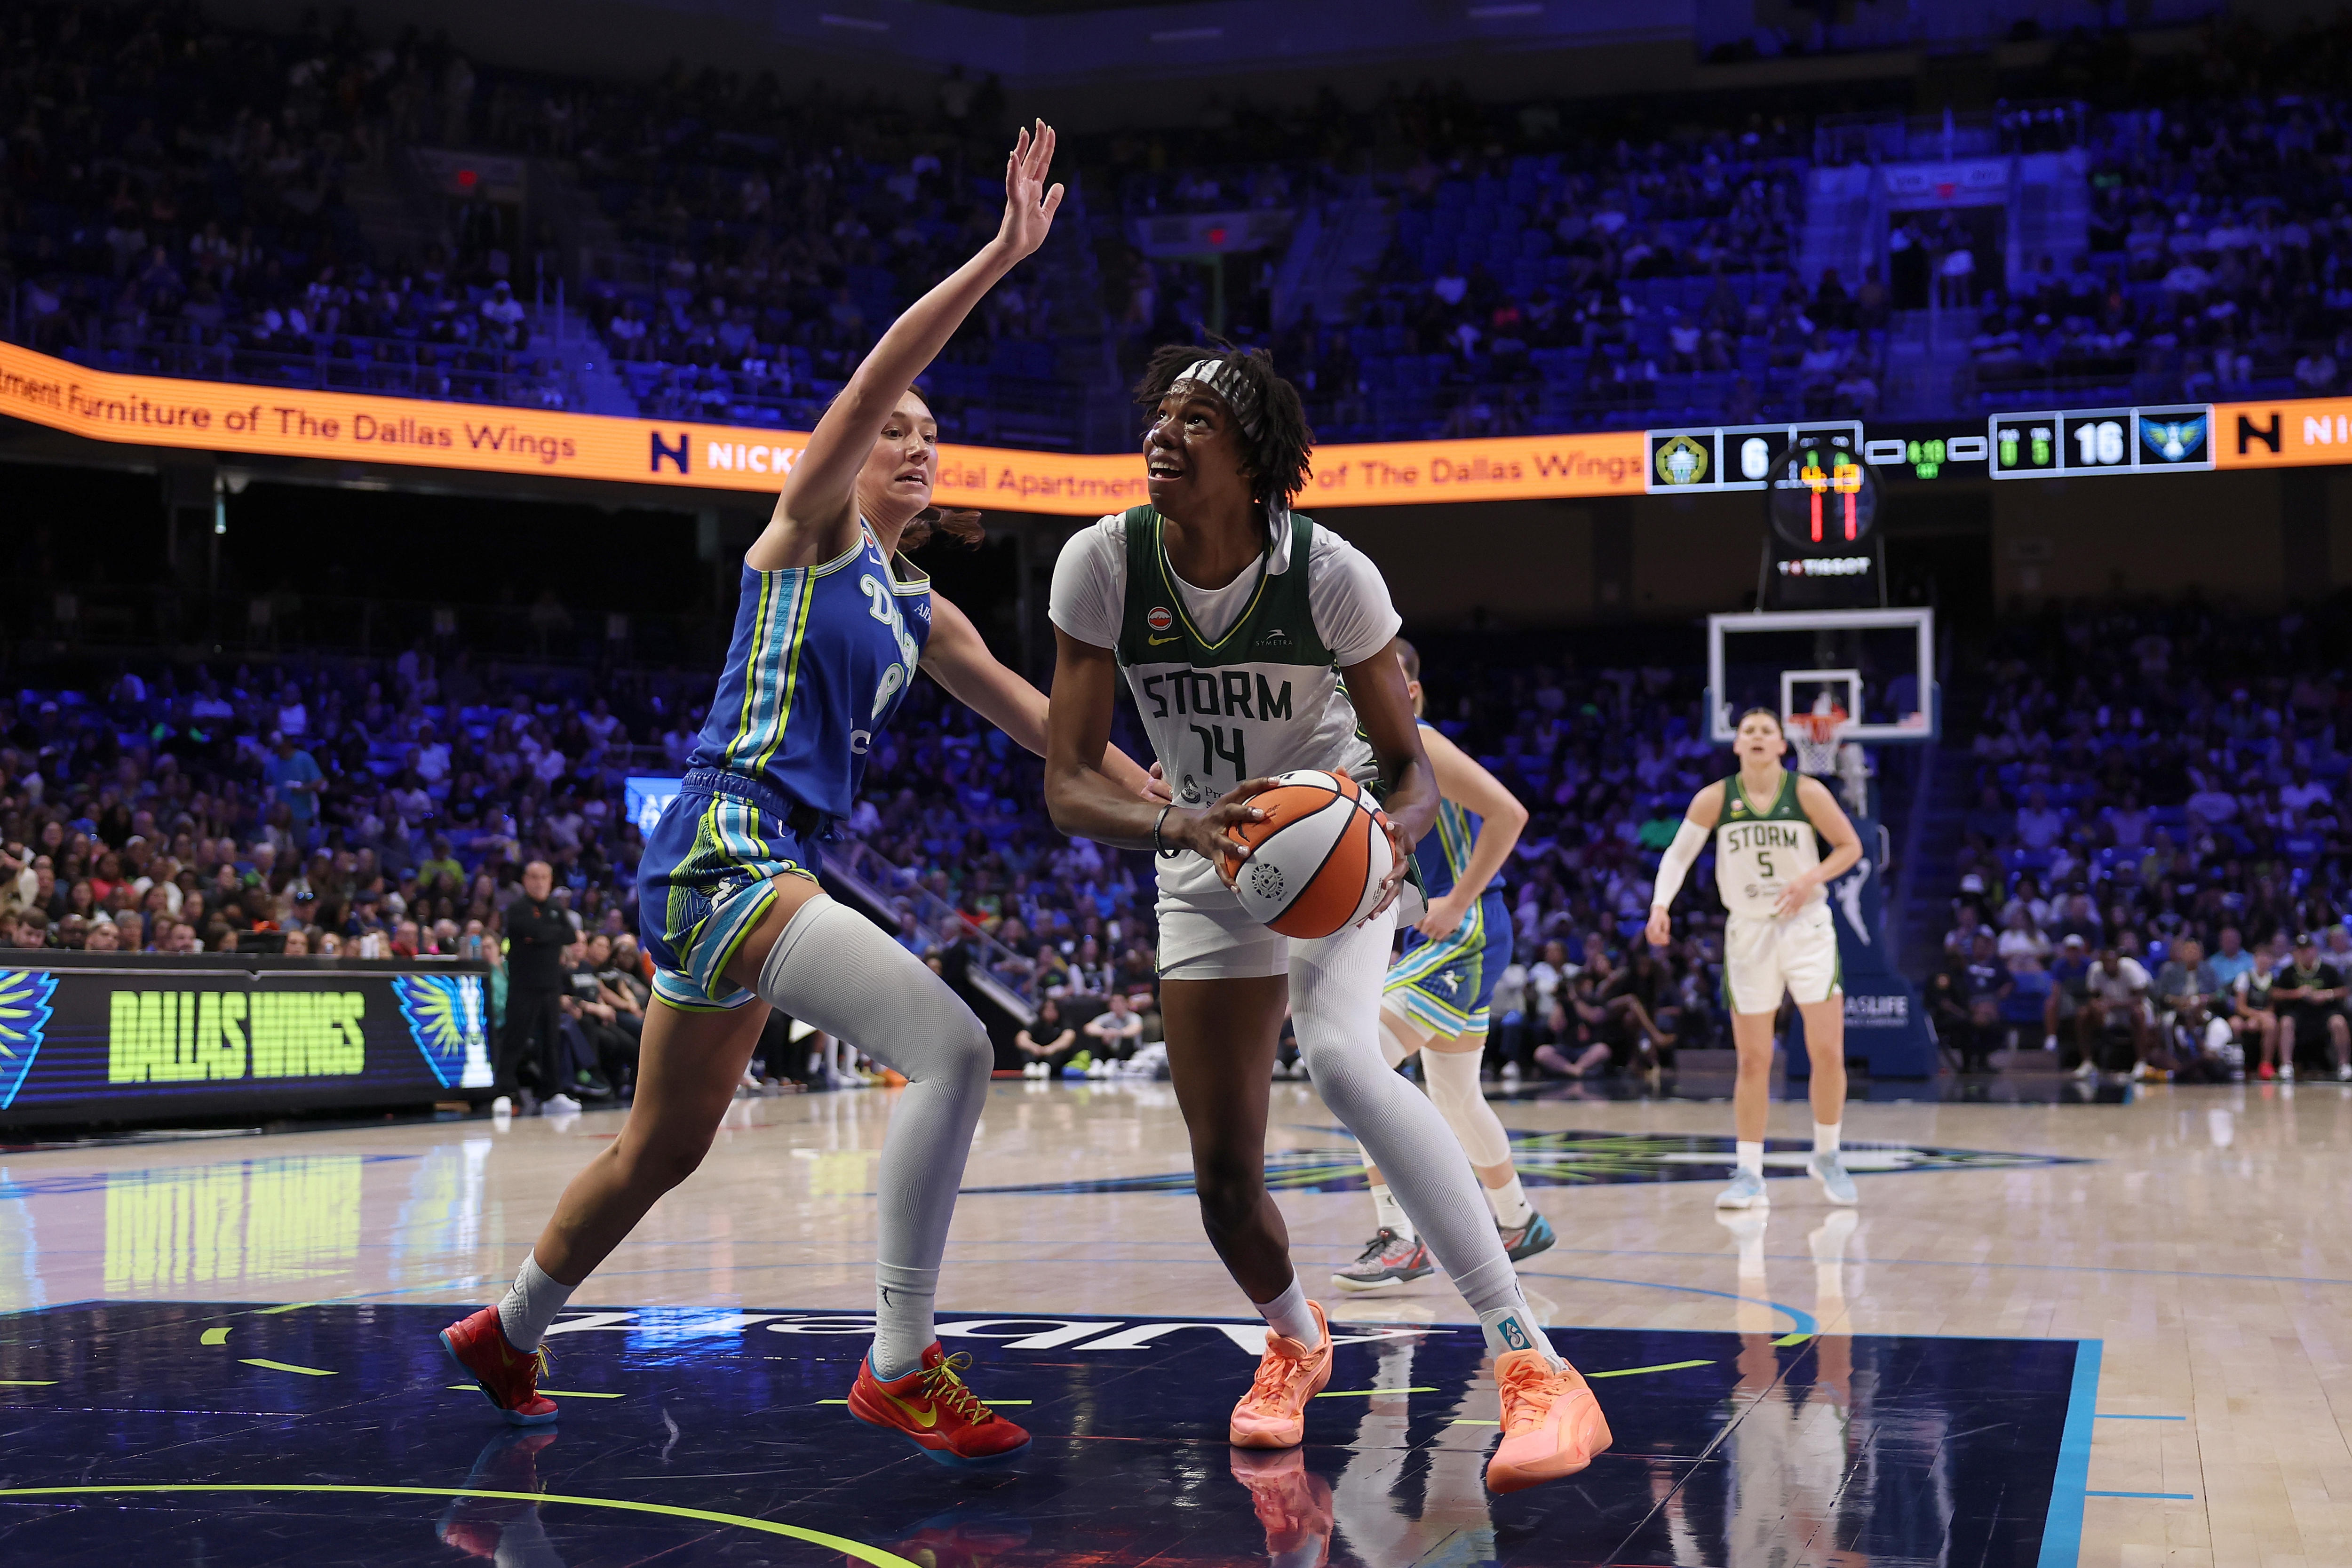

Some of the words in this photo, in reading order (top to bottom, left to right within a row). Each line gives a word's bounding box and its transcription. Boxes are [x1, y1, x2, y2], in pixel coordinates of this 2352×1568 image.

[68, 383, 211, 427] Furniture
[224, 405, 261, 430] of
[274, 407, 340, 438] The
[354, 414, 453, 446] Dallas
[463, 421, 576, 464] Wings
[2074, 421, 2123, 465] 16
[2304, 414, 2352, 446] NI
[998, 468, 1146, 500] Apartmen
[1359, 460, 1419, 487] The
[1430, 456, 1522, 485] Dallas
[1534, 450, 1643, 485] Wings
[1741, 437, 1769, 480] 6
[1142, 669, 1292, 722] STORM
[1727, 824, 1799, 853] STORM
[1757, 850, 1774, 878] 5
[108, 990, 247, 1083] DALLAS
[249, 991, 366, 1079] WINGS
